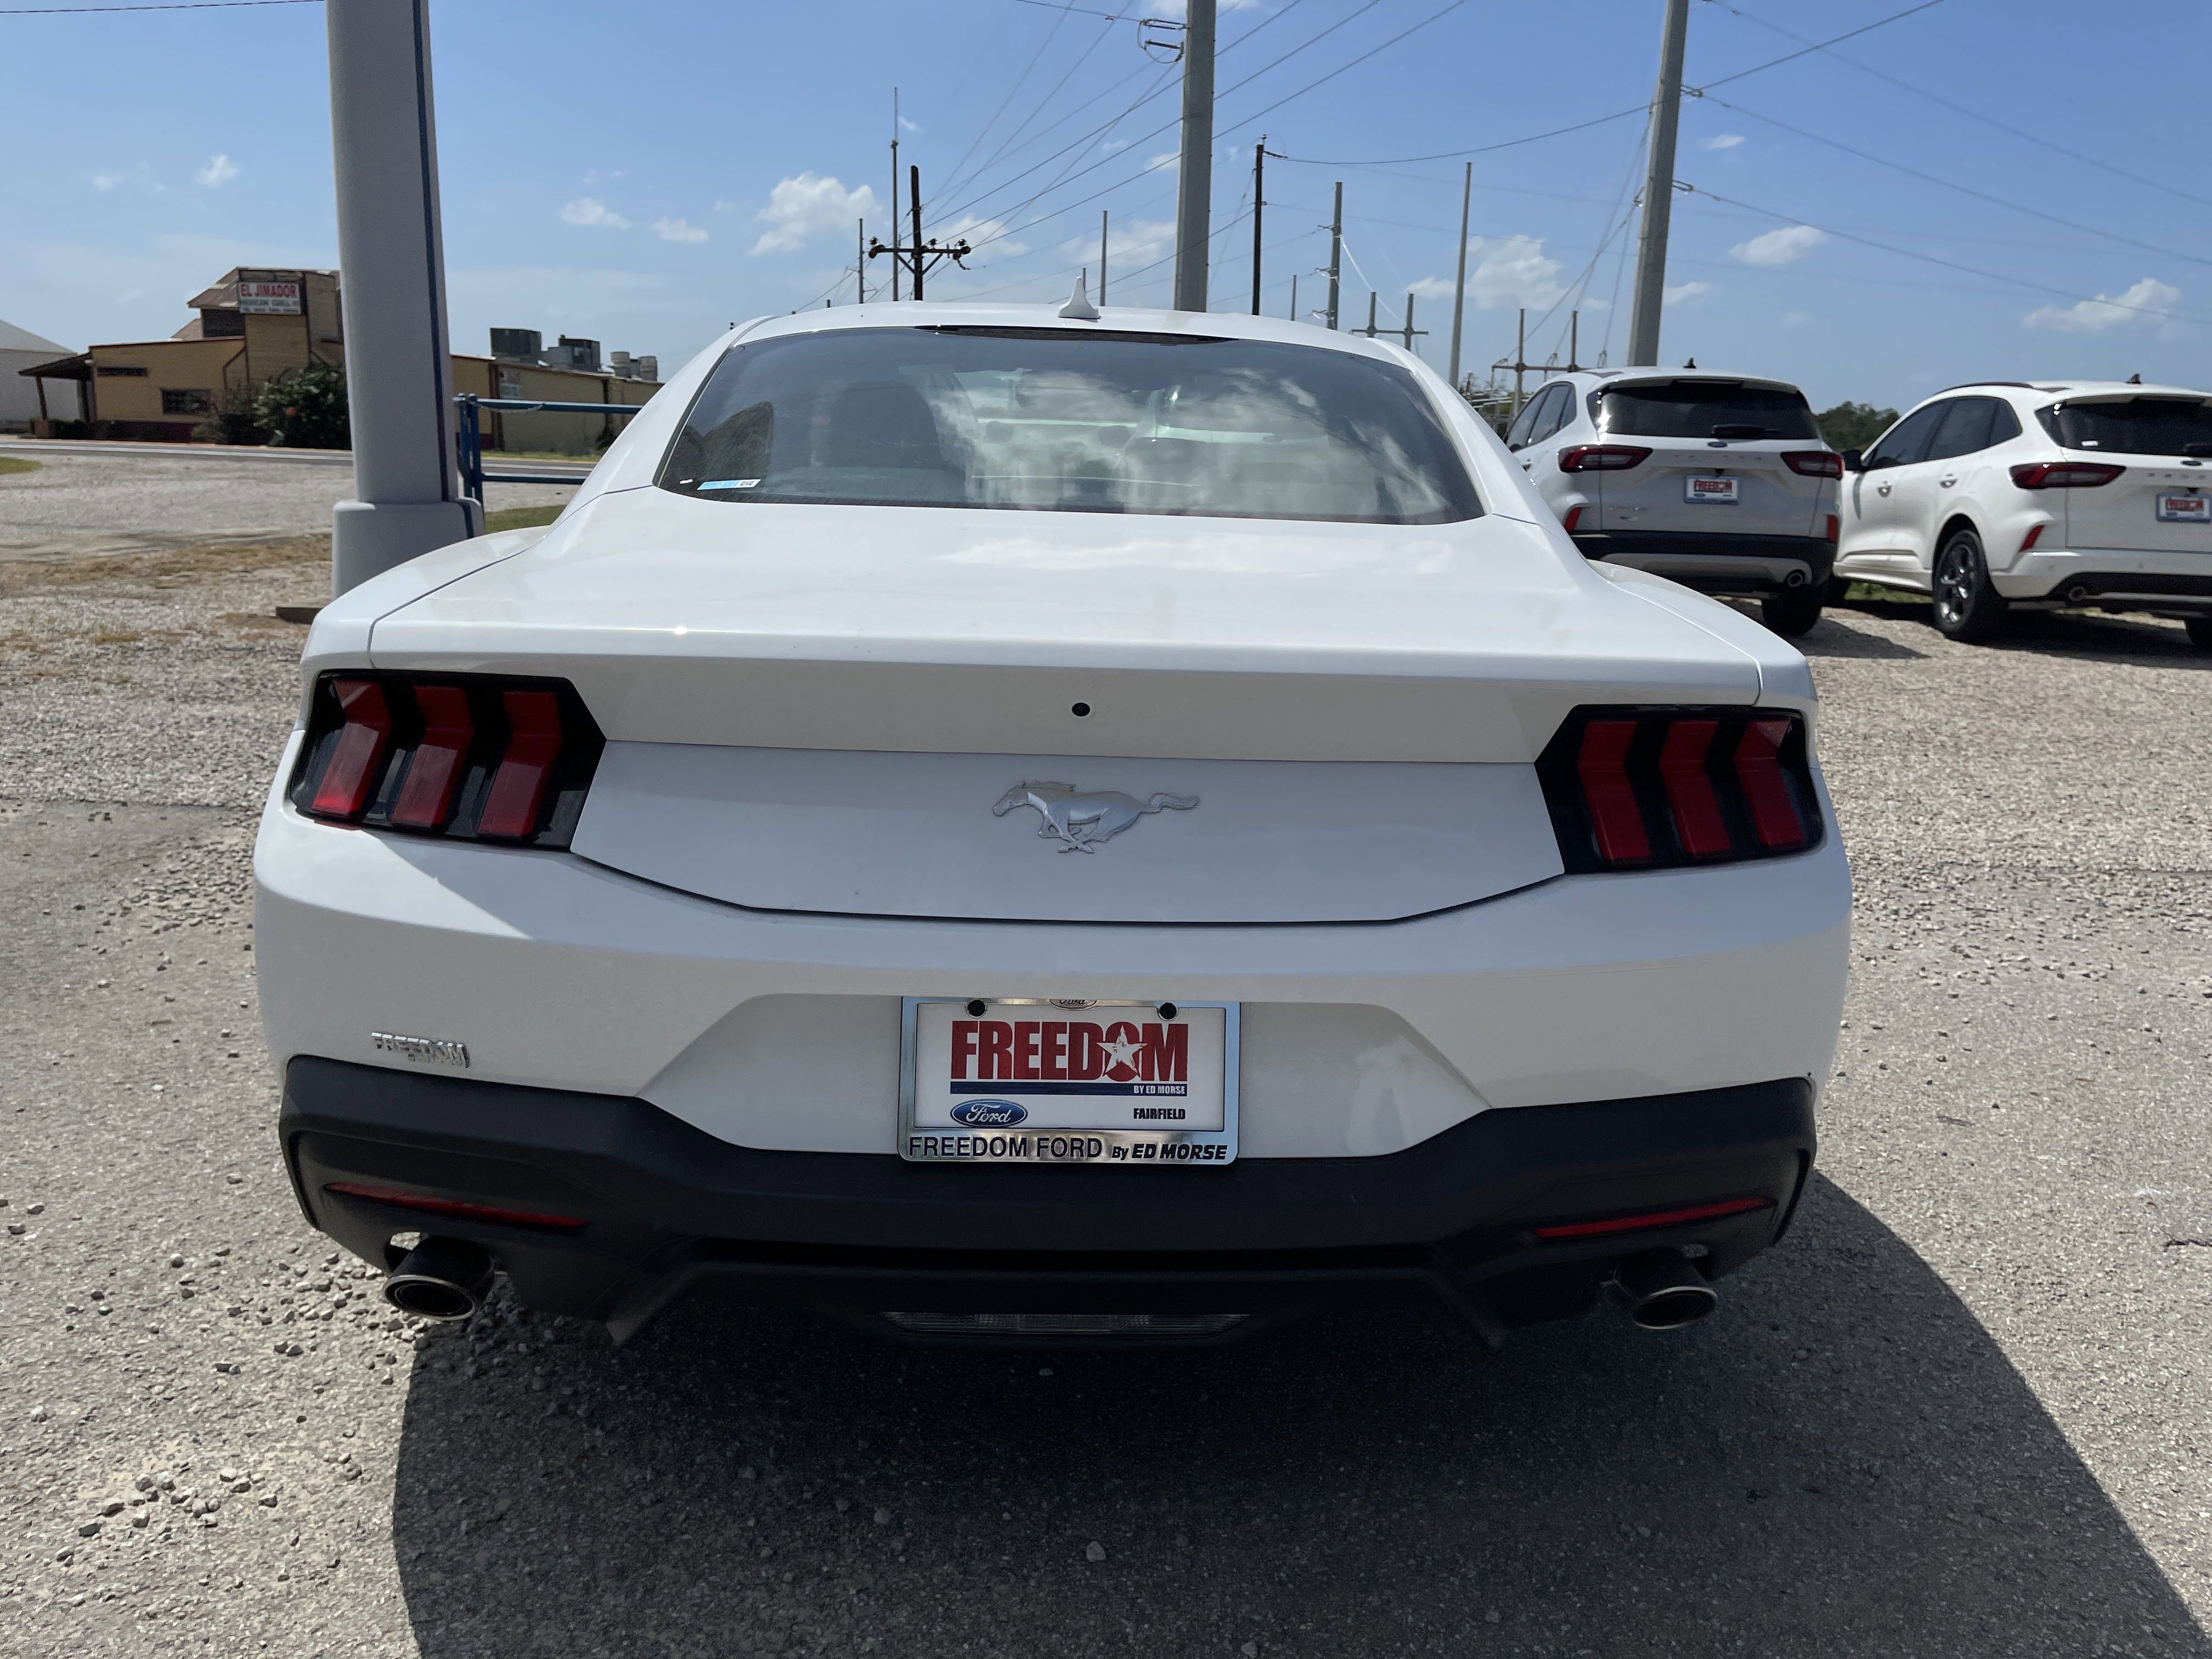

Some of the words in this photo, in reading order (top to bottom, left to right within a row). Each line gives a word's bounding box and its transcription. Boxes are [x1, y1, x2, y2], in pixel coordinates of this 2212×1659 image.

[241, 284, 252, 296] EL
[255, 284, 296, 297] JIMADOR
[951, 1020, 1188, 1082] FREEDOM
[1133, 1085, 1144, 1094] BY
[1146, 1086, 1156, 1094] ED
[1158, 1086, 1186, 1094] MORSE
[966, 1103, 1012, 1123] Ford
[1133, 1108, 1186, 1120] FAIRFIELD
[909, 1136, 1027, 1158] FREEDOM
[1037, 1137, 1102, 1158] FORD
[1131, 1143, 1156, 1159] ED
[1159, 1144, 1228, 1160] MORSE
